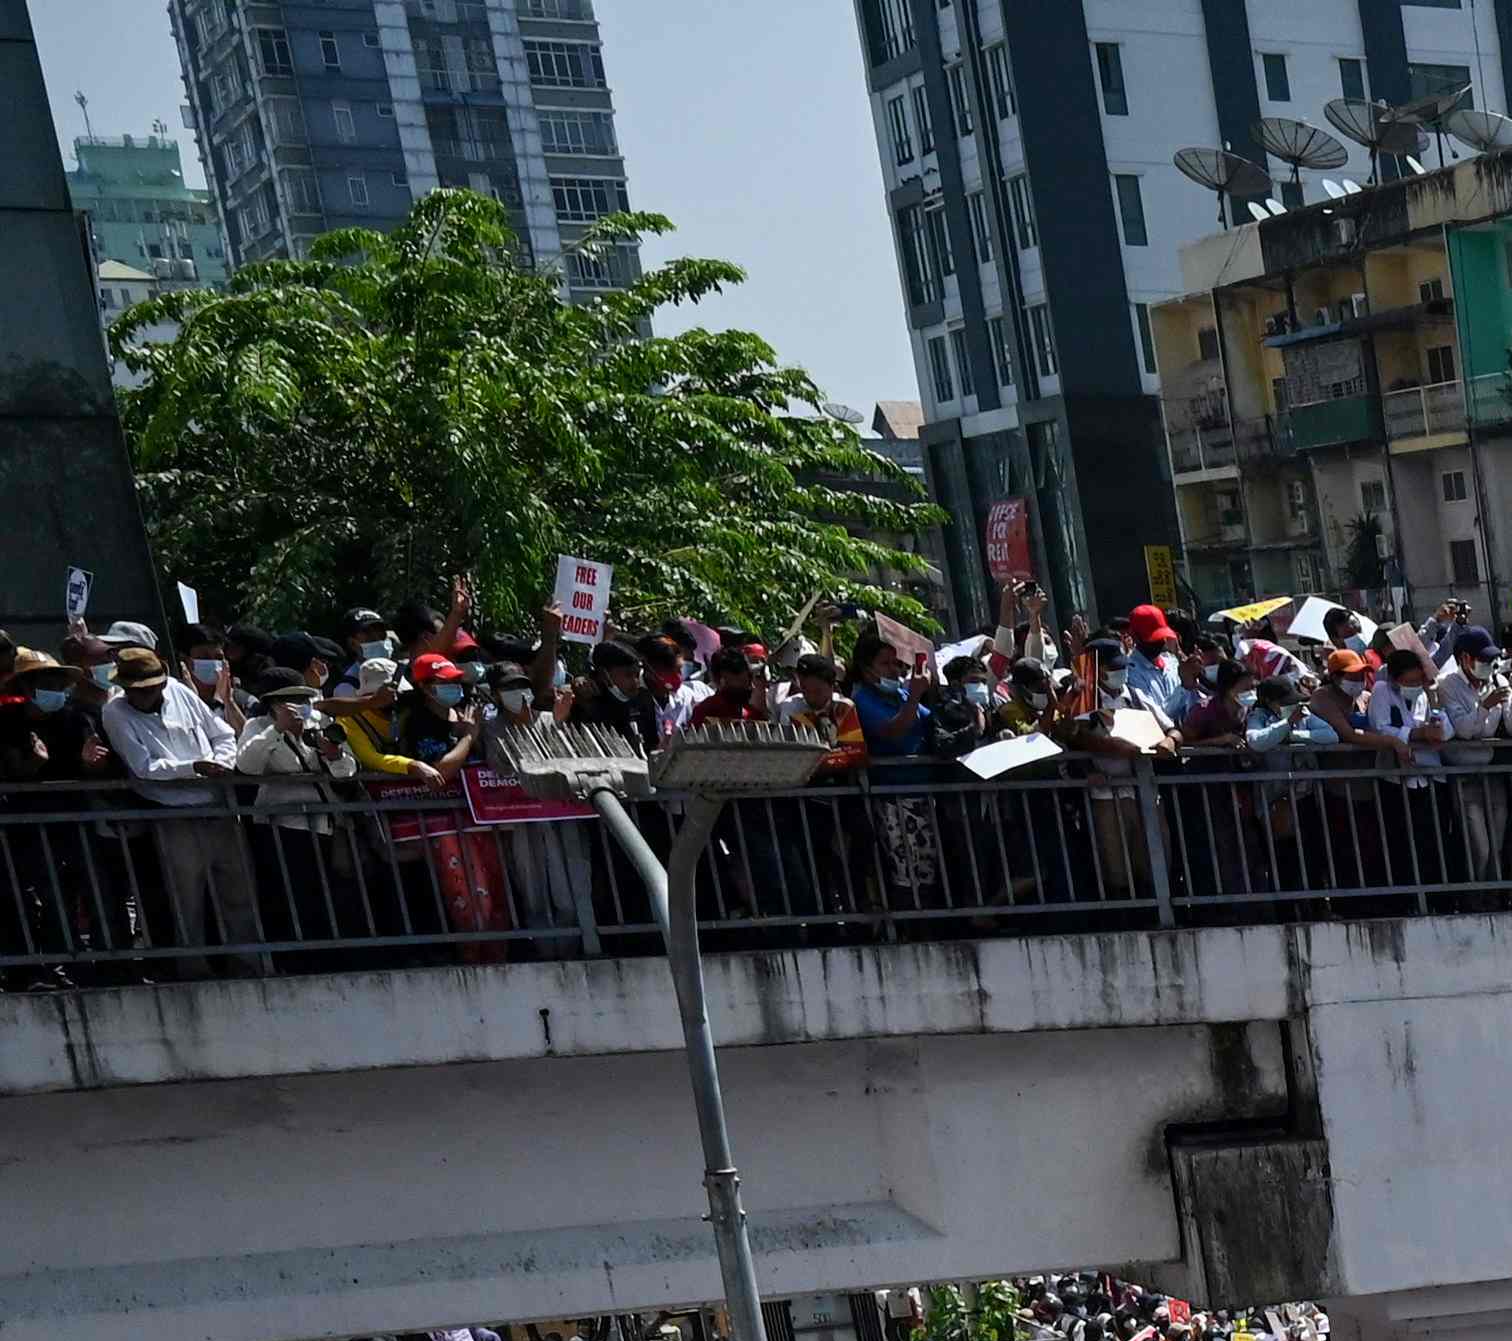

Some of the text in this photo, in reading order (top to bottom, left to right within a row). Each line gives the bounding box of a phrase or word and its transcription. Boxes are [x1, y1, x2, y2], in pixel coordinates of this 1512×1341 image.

[574, 565, 597, 587] FREE
[572, 591, 594, 611] OUR
[562, 613, 600, 638] EADERS
